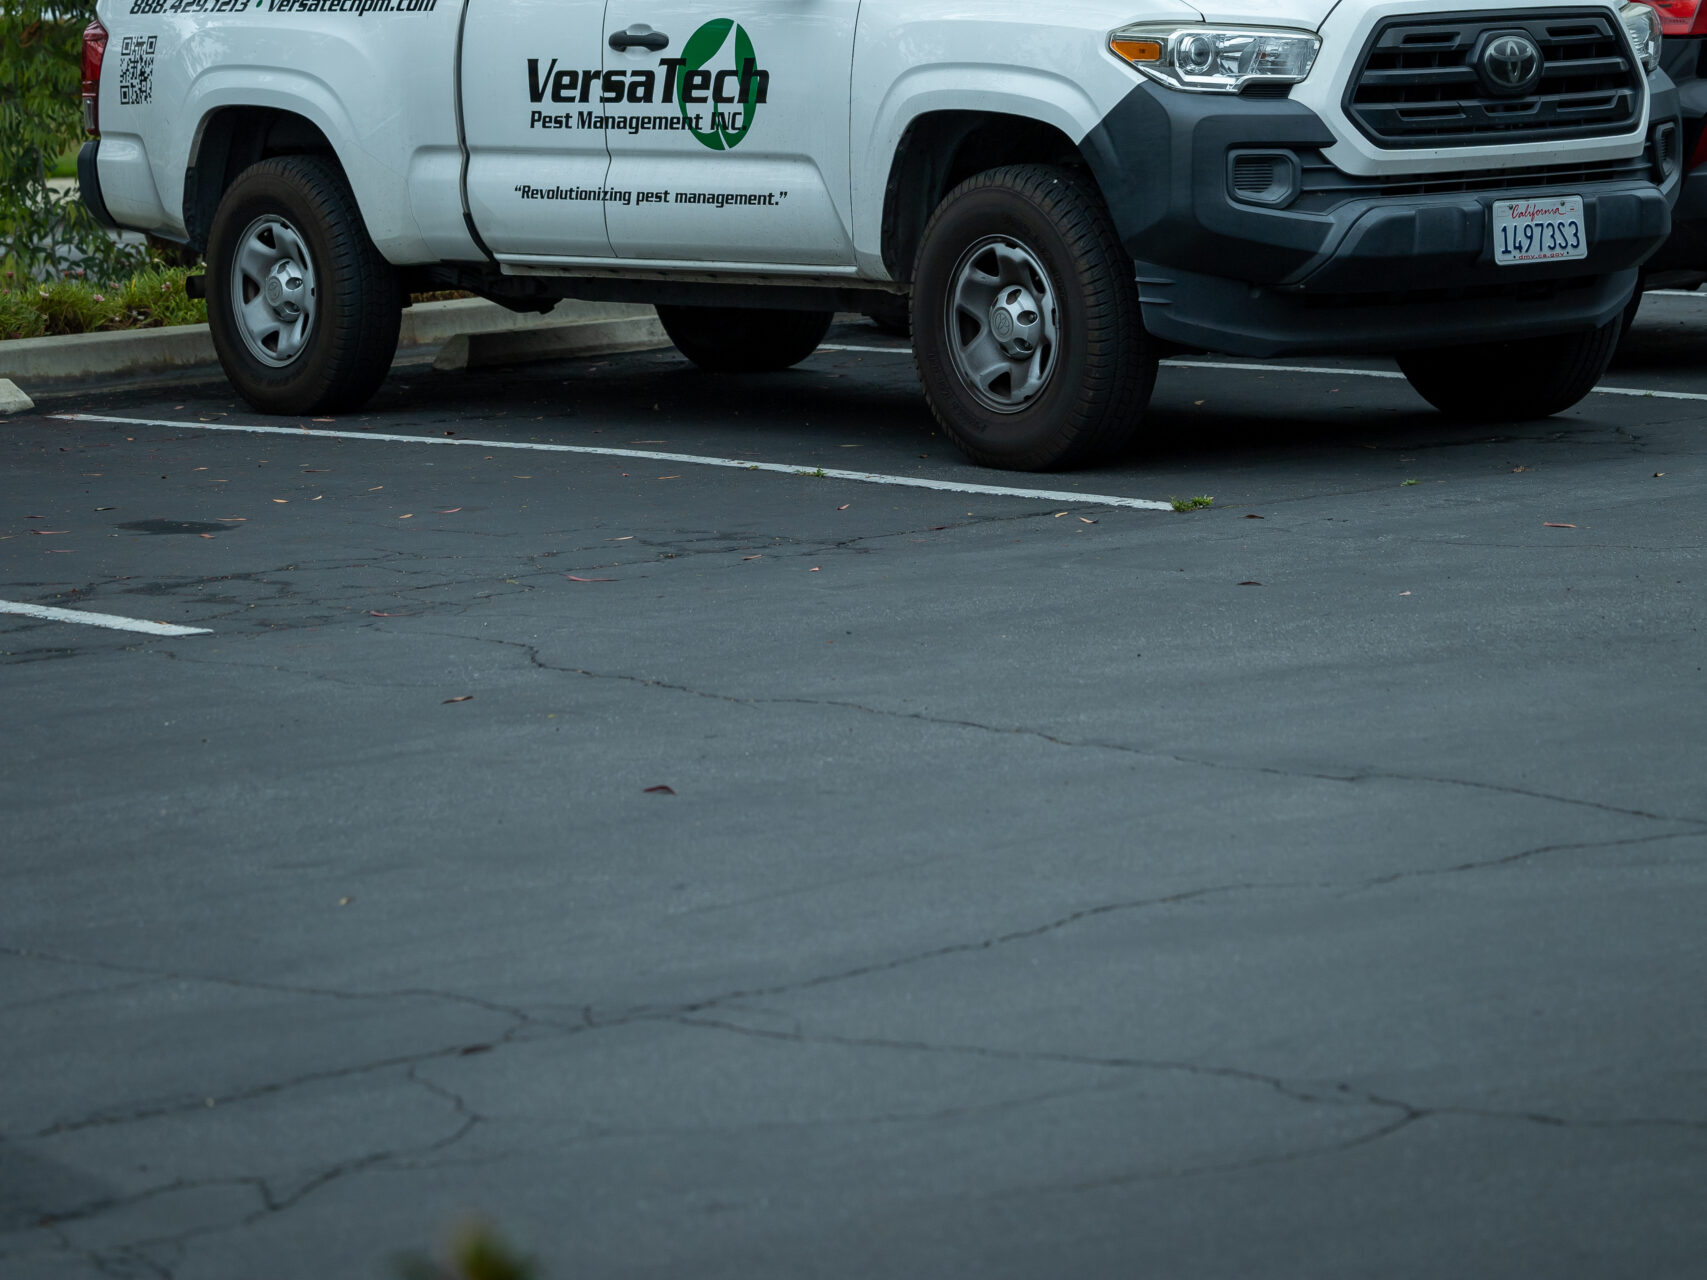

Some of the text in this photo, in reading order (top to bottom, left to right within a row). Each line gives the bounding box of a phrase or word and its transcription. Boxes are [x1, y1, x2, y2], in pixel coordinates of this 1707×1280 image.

[527, 57, 769, 104] VersaTech
[530, 110, 747, 135] Pest Management INC.
[514, 185, 788, 208] “Revolutionizing pest management.”
[1511, 203, 1566, 222] California
[1501, 220, 1580, 255] 14973S3
[1518, 252, 1565, 260] dmv.ca.gov
